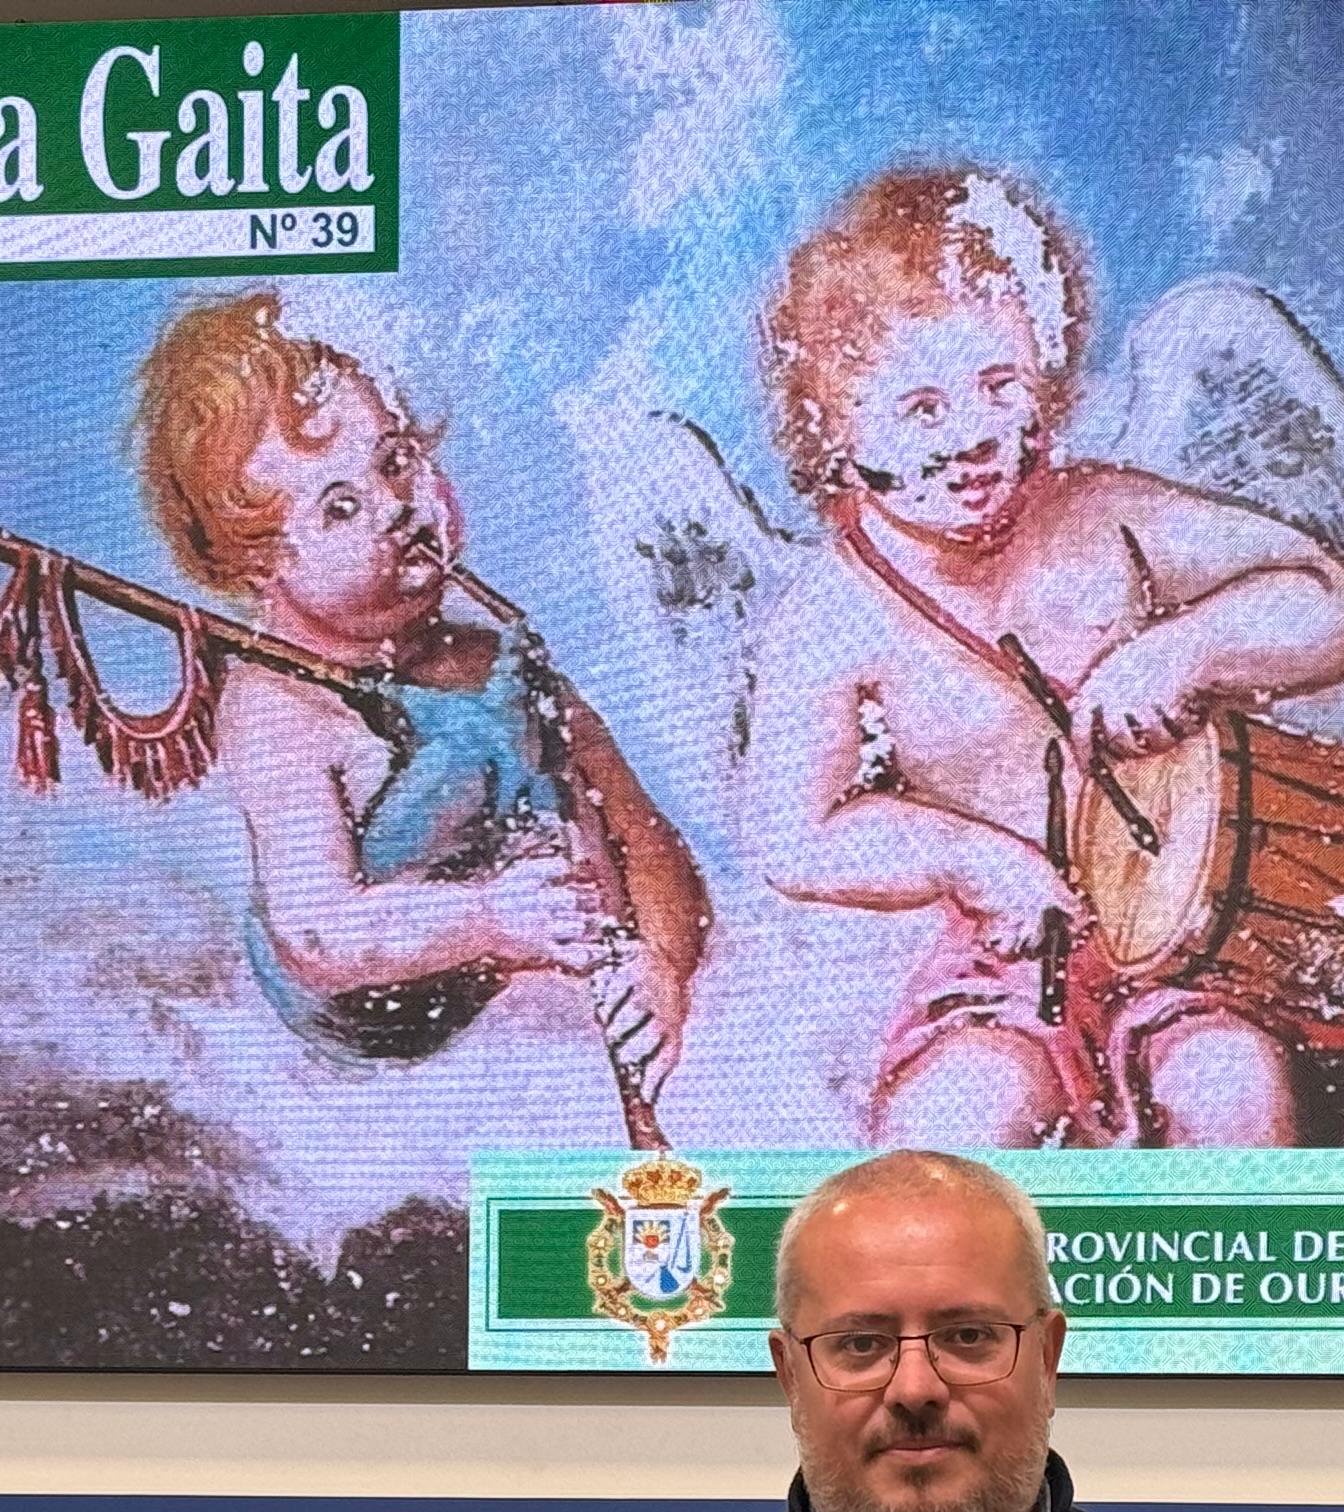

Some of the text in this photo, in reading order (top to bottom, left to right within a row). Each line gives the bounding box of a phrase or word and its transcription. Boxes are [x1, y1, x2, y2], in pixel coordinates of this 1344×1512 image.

[79, 40, 375, 201] Gaita
[249, 211, 297, 251] Nº
[310, 210, 361, 249] 39
[1046, 1230, 1277, 1263] ROVINCIAL
[1192, 1272, 1245, 1304] DE
